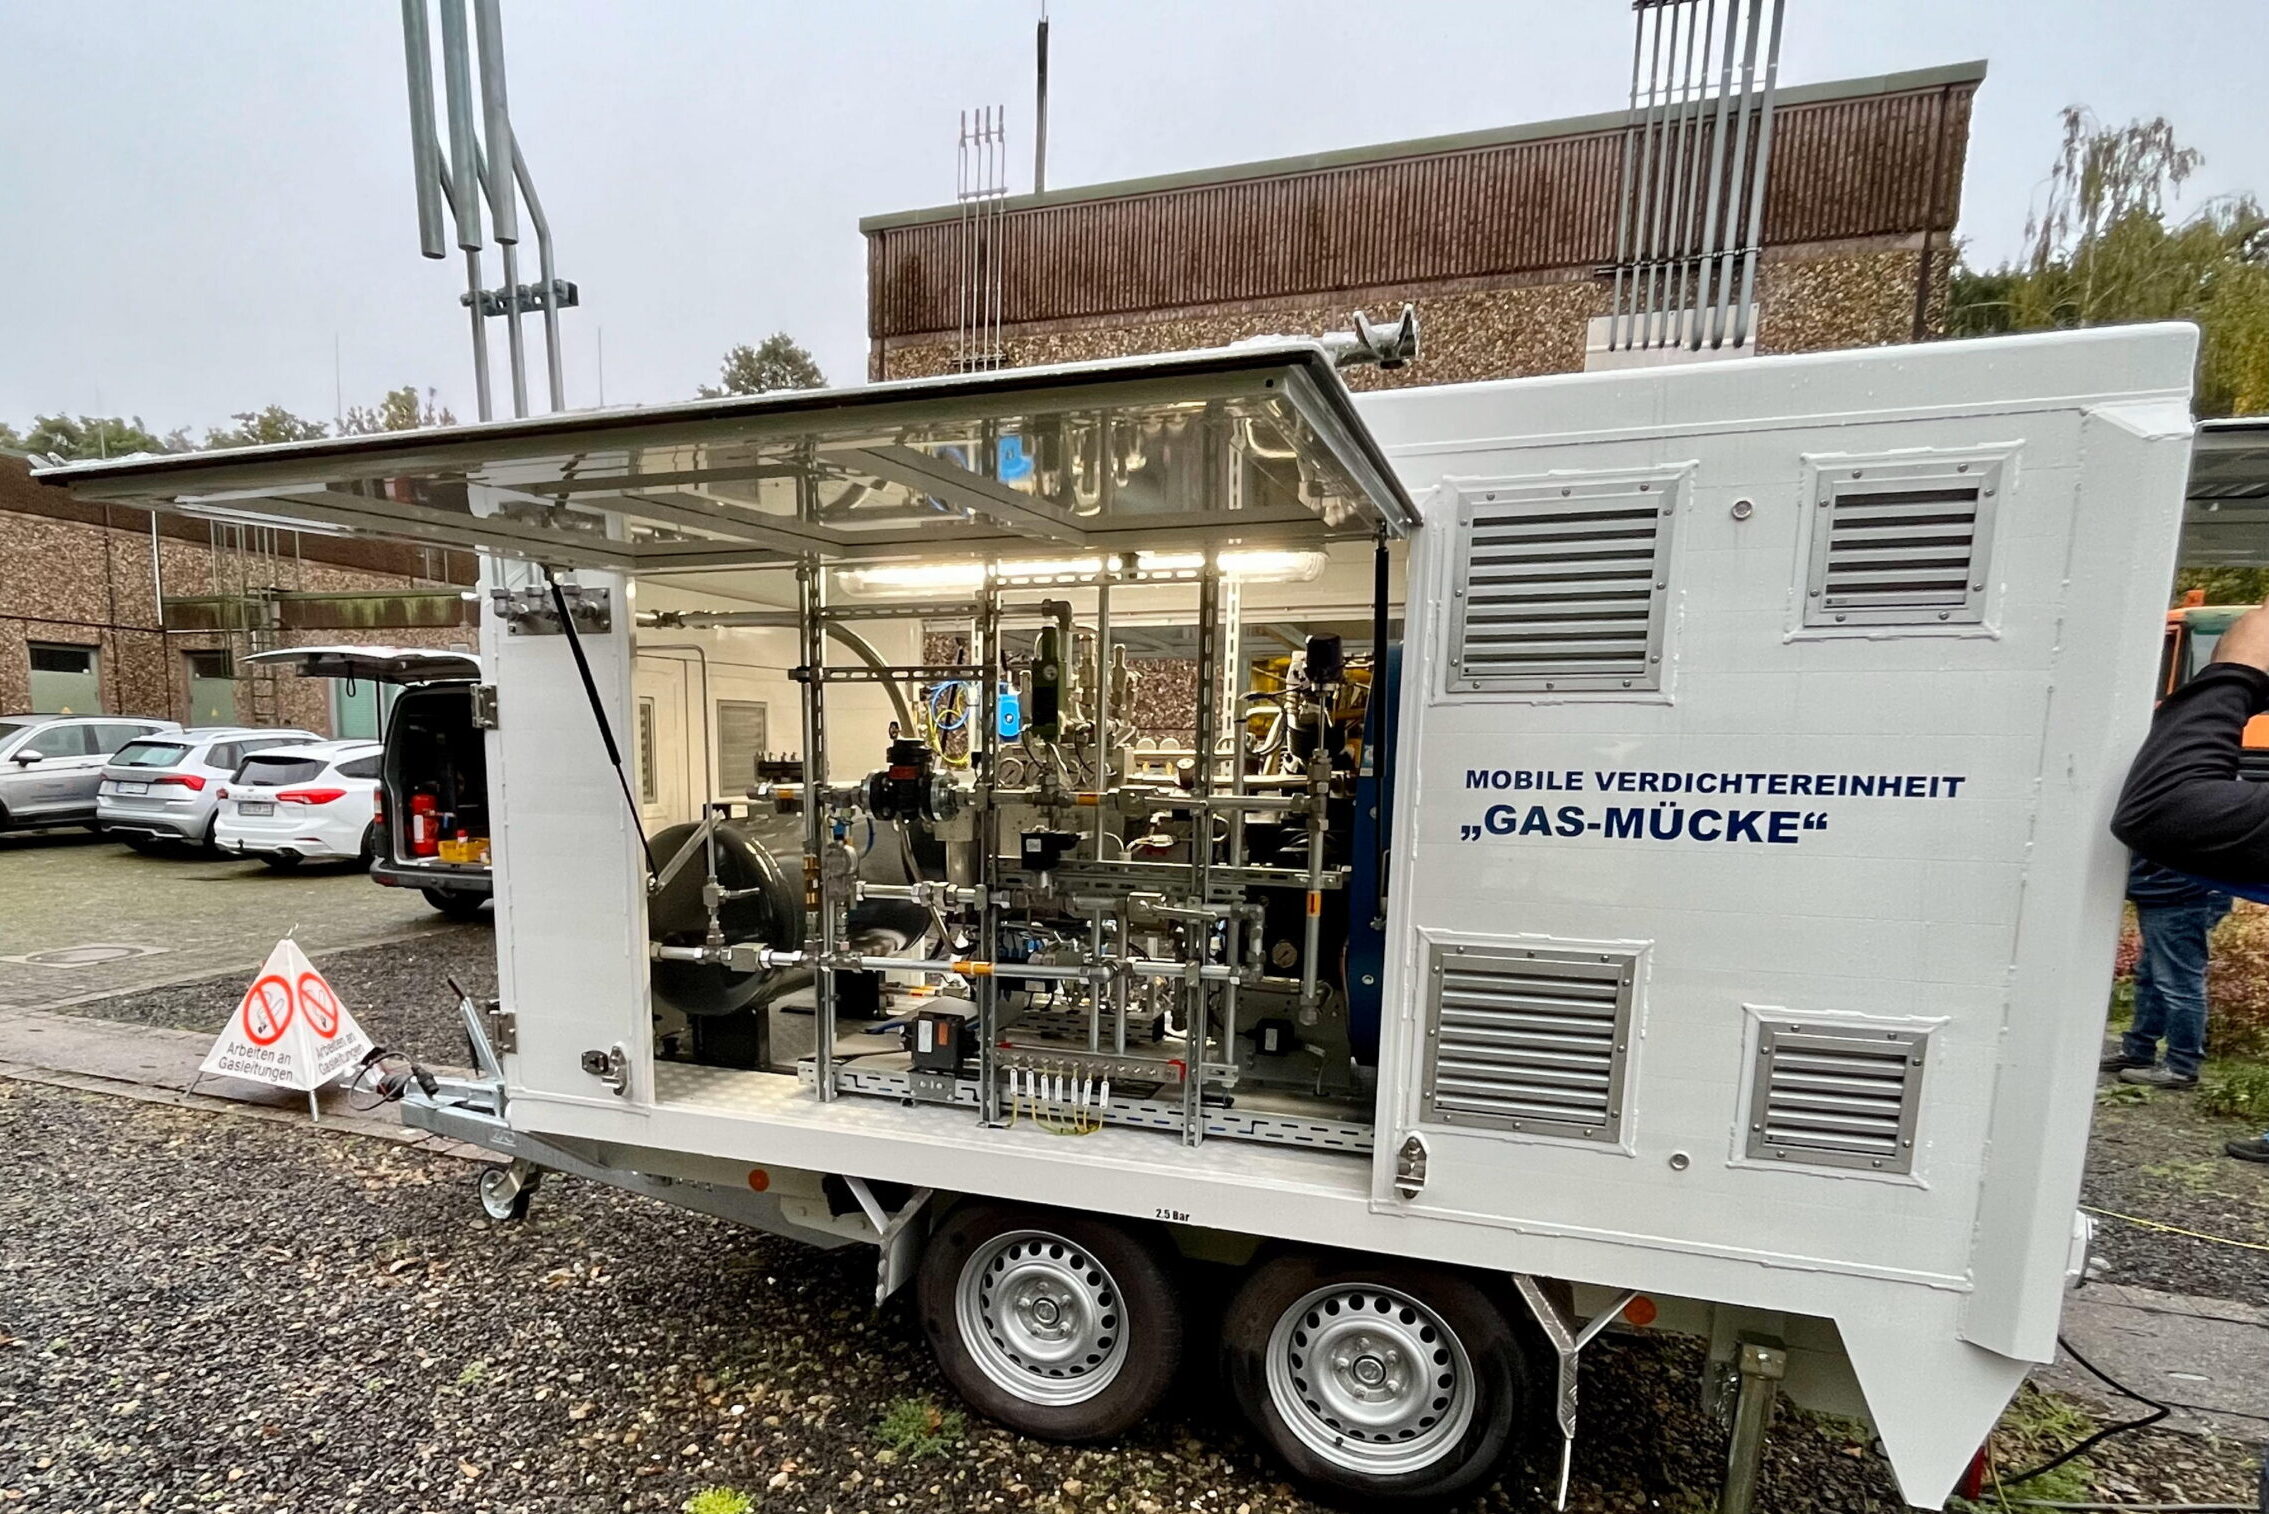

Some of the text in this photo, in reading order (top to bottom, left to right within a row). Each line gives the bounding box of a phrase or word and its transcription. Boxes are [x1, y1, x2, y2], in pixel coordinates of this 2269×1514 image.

[1466, 769, 1966, 798] MOBILE VERDICHTEREINHEIT
[226, 1041, 292, 1065] Arbeiten an
[218, 1056, 293, 1082] Gasleitungen
[1172, 1210, 1190, 1222] Bar
